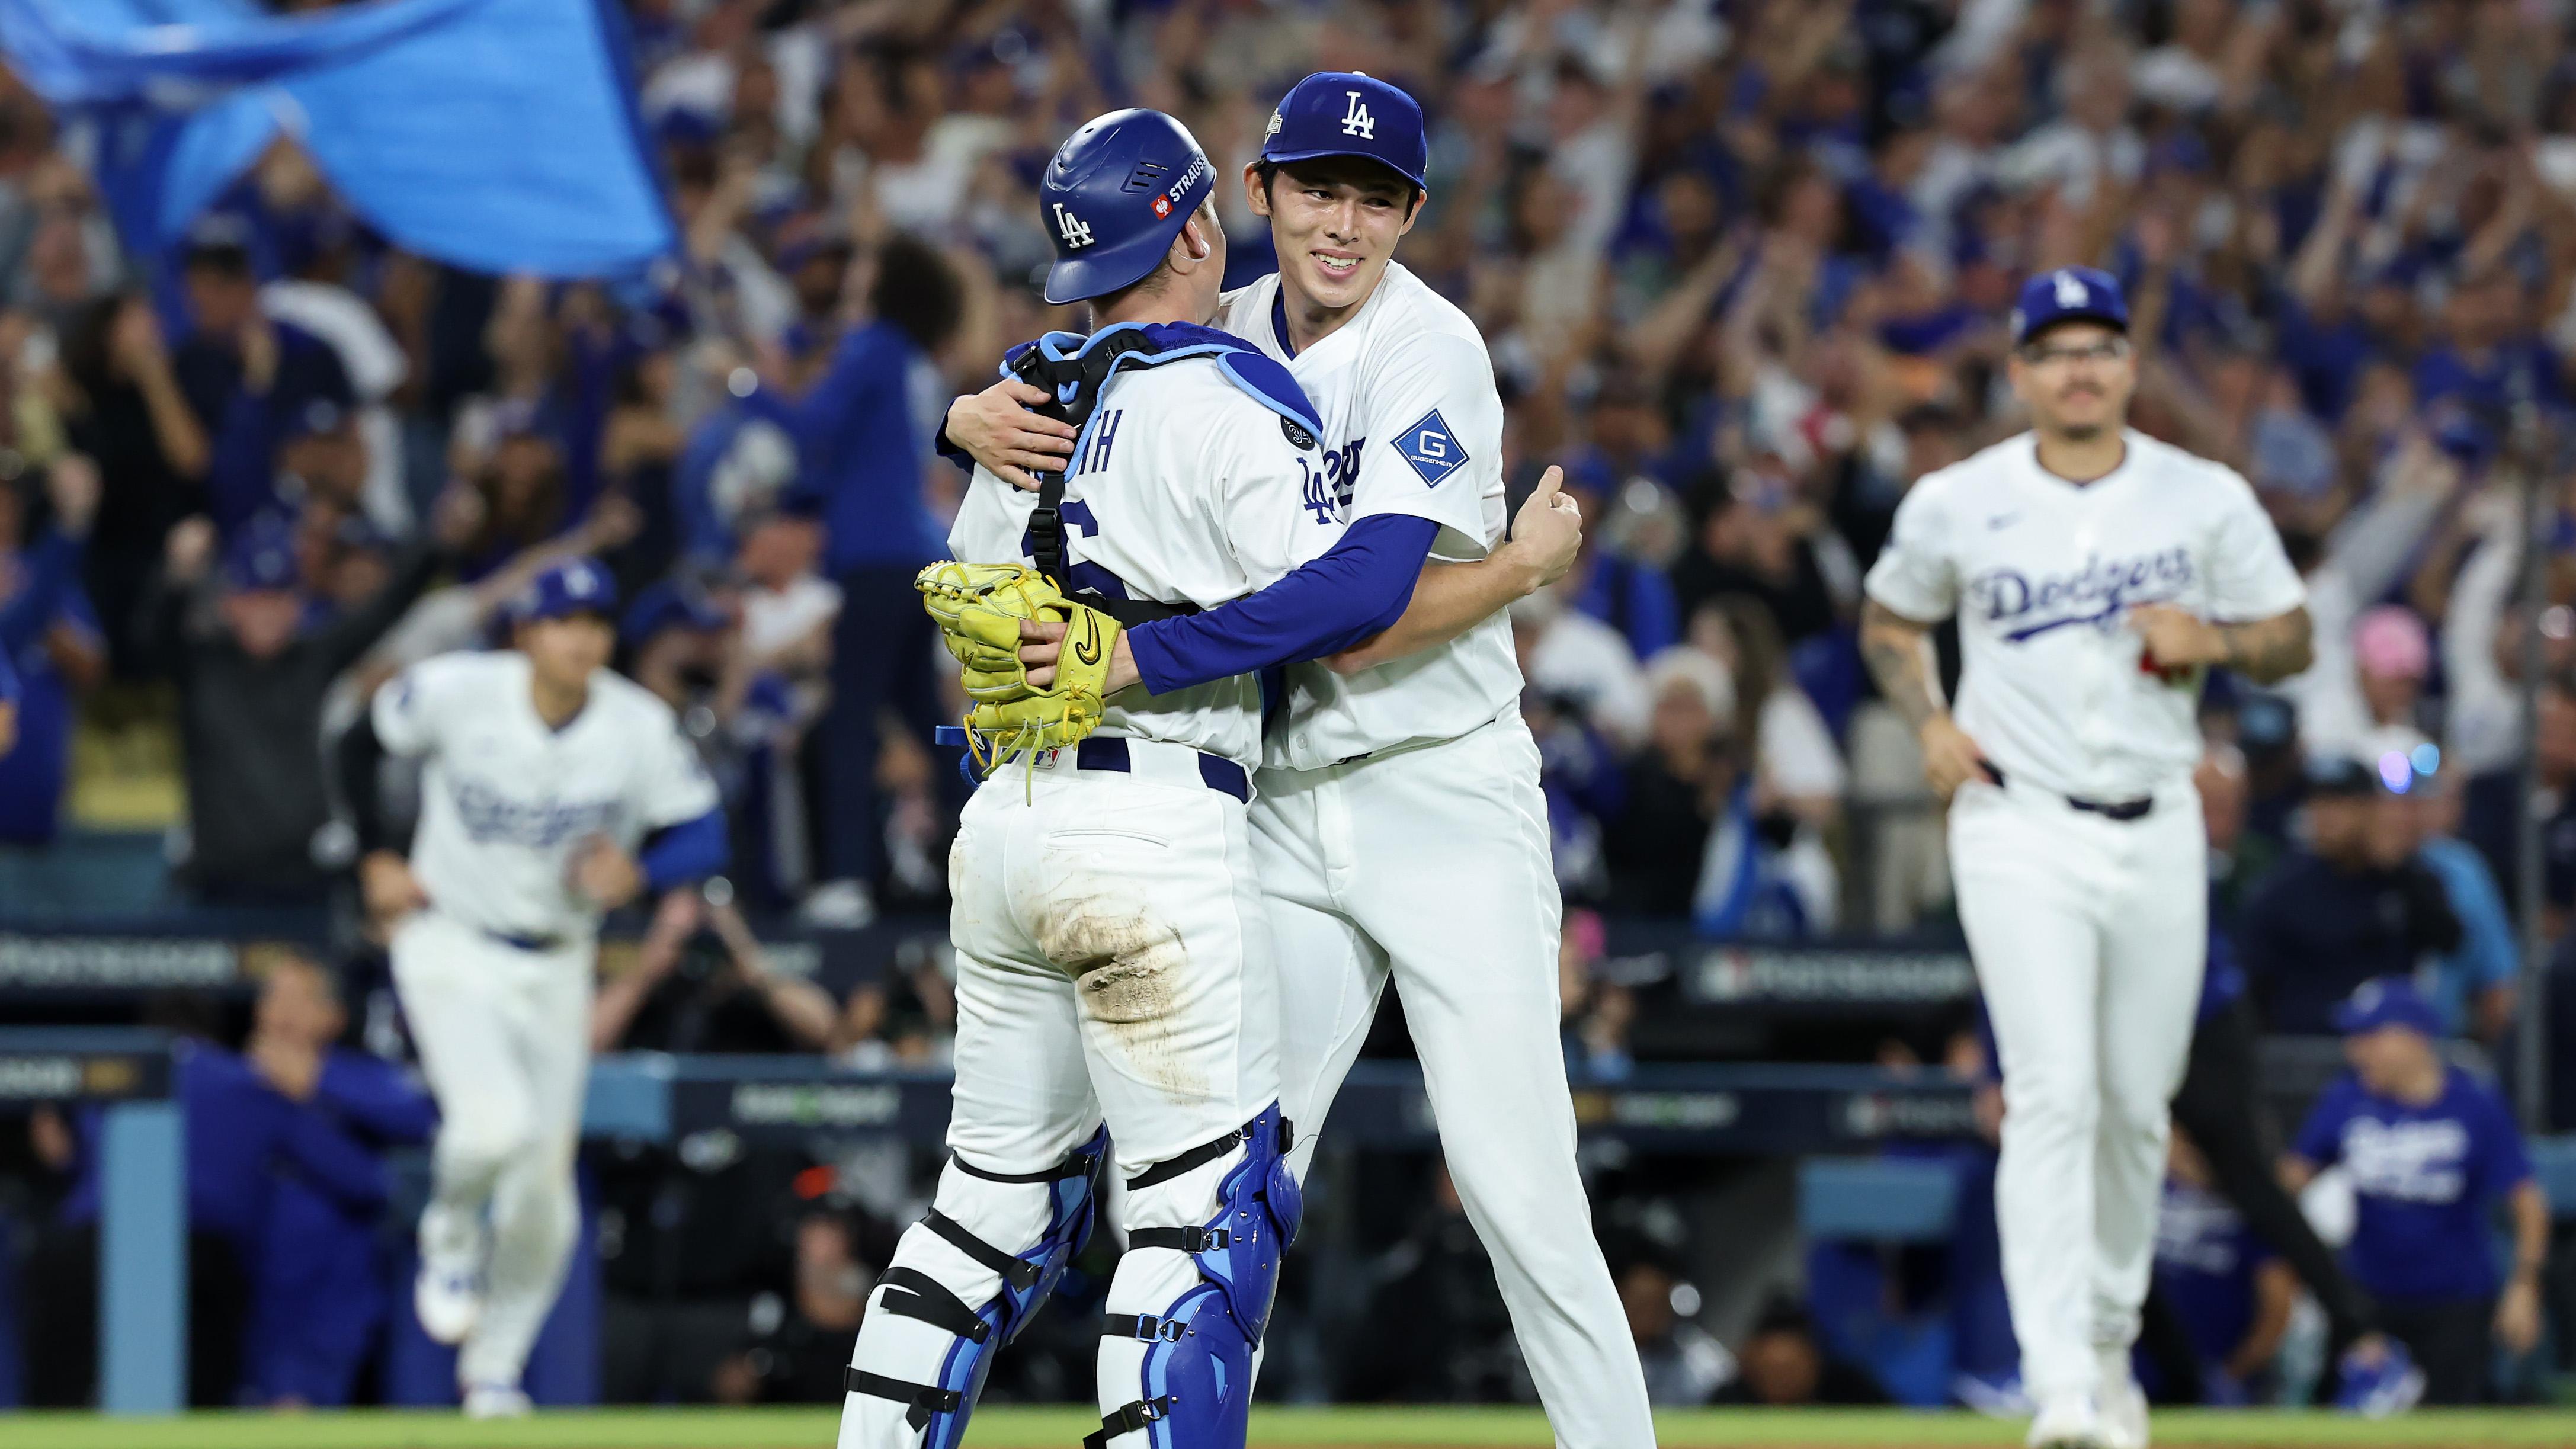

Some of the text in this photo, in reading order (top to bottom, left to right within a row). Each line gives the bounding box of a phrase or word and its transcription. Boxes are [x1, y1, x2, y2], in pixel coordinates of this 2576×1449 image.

[1341, 91, 1374, 140] LA
[1170, 153, 1207, 202] STRAUSS
[1053, 203, 1095, 248] LA
[1411, 455, 1452, 467] GUGGENHEIM
[1419, 430, 1446, 457] G
[1296, 457, 1345, 525] LA
